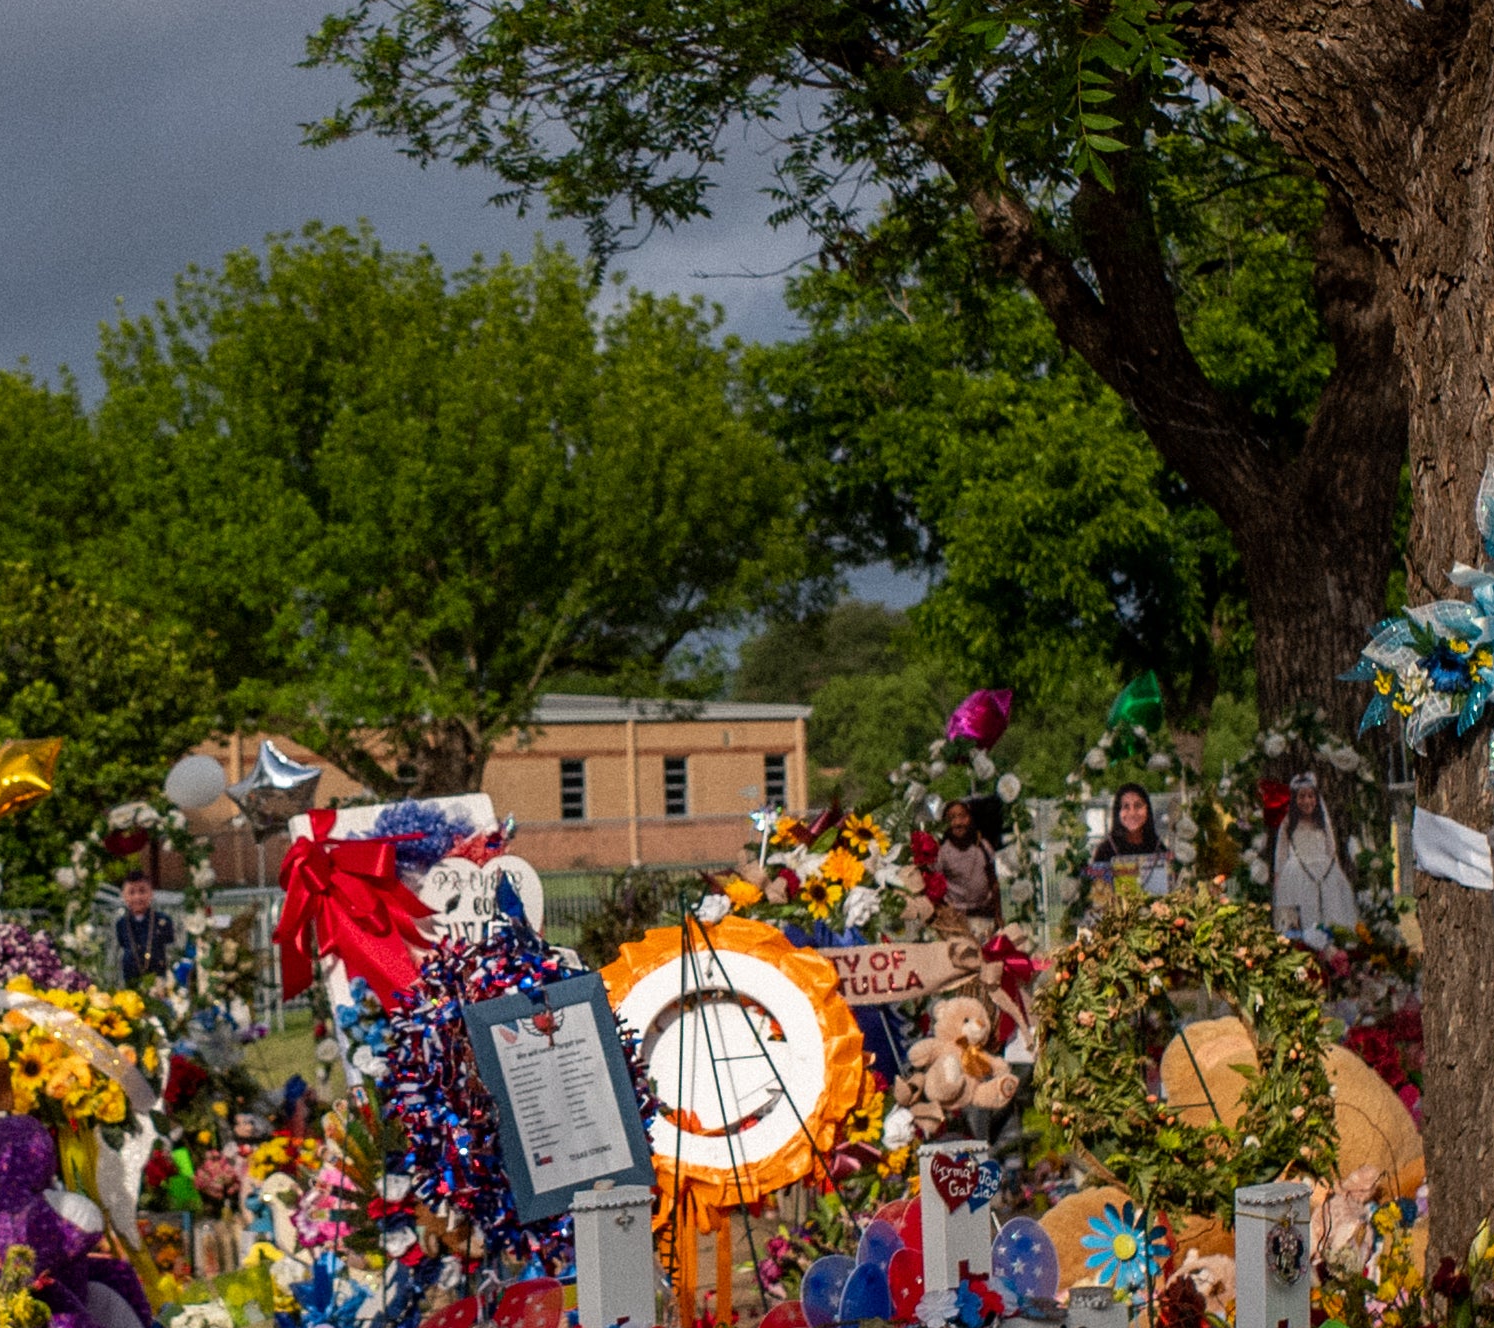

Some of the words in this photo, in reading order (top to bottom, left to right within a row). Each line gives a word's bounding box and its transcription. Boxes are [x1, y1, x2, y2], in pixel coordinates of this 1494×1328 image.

[832, 953, 860, 974] TY
[869, 949, 906, 972] OF
[837, 970, 924, 997] TULLA
